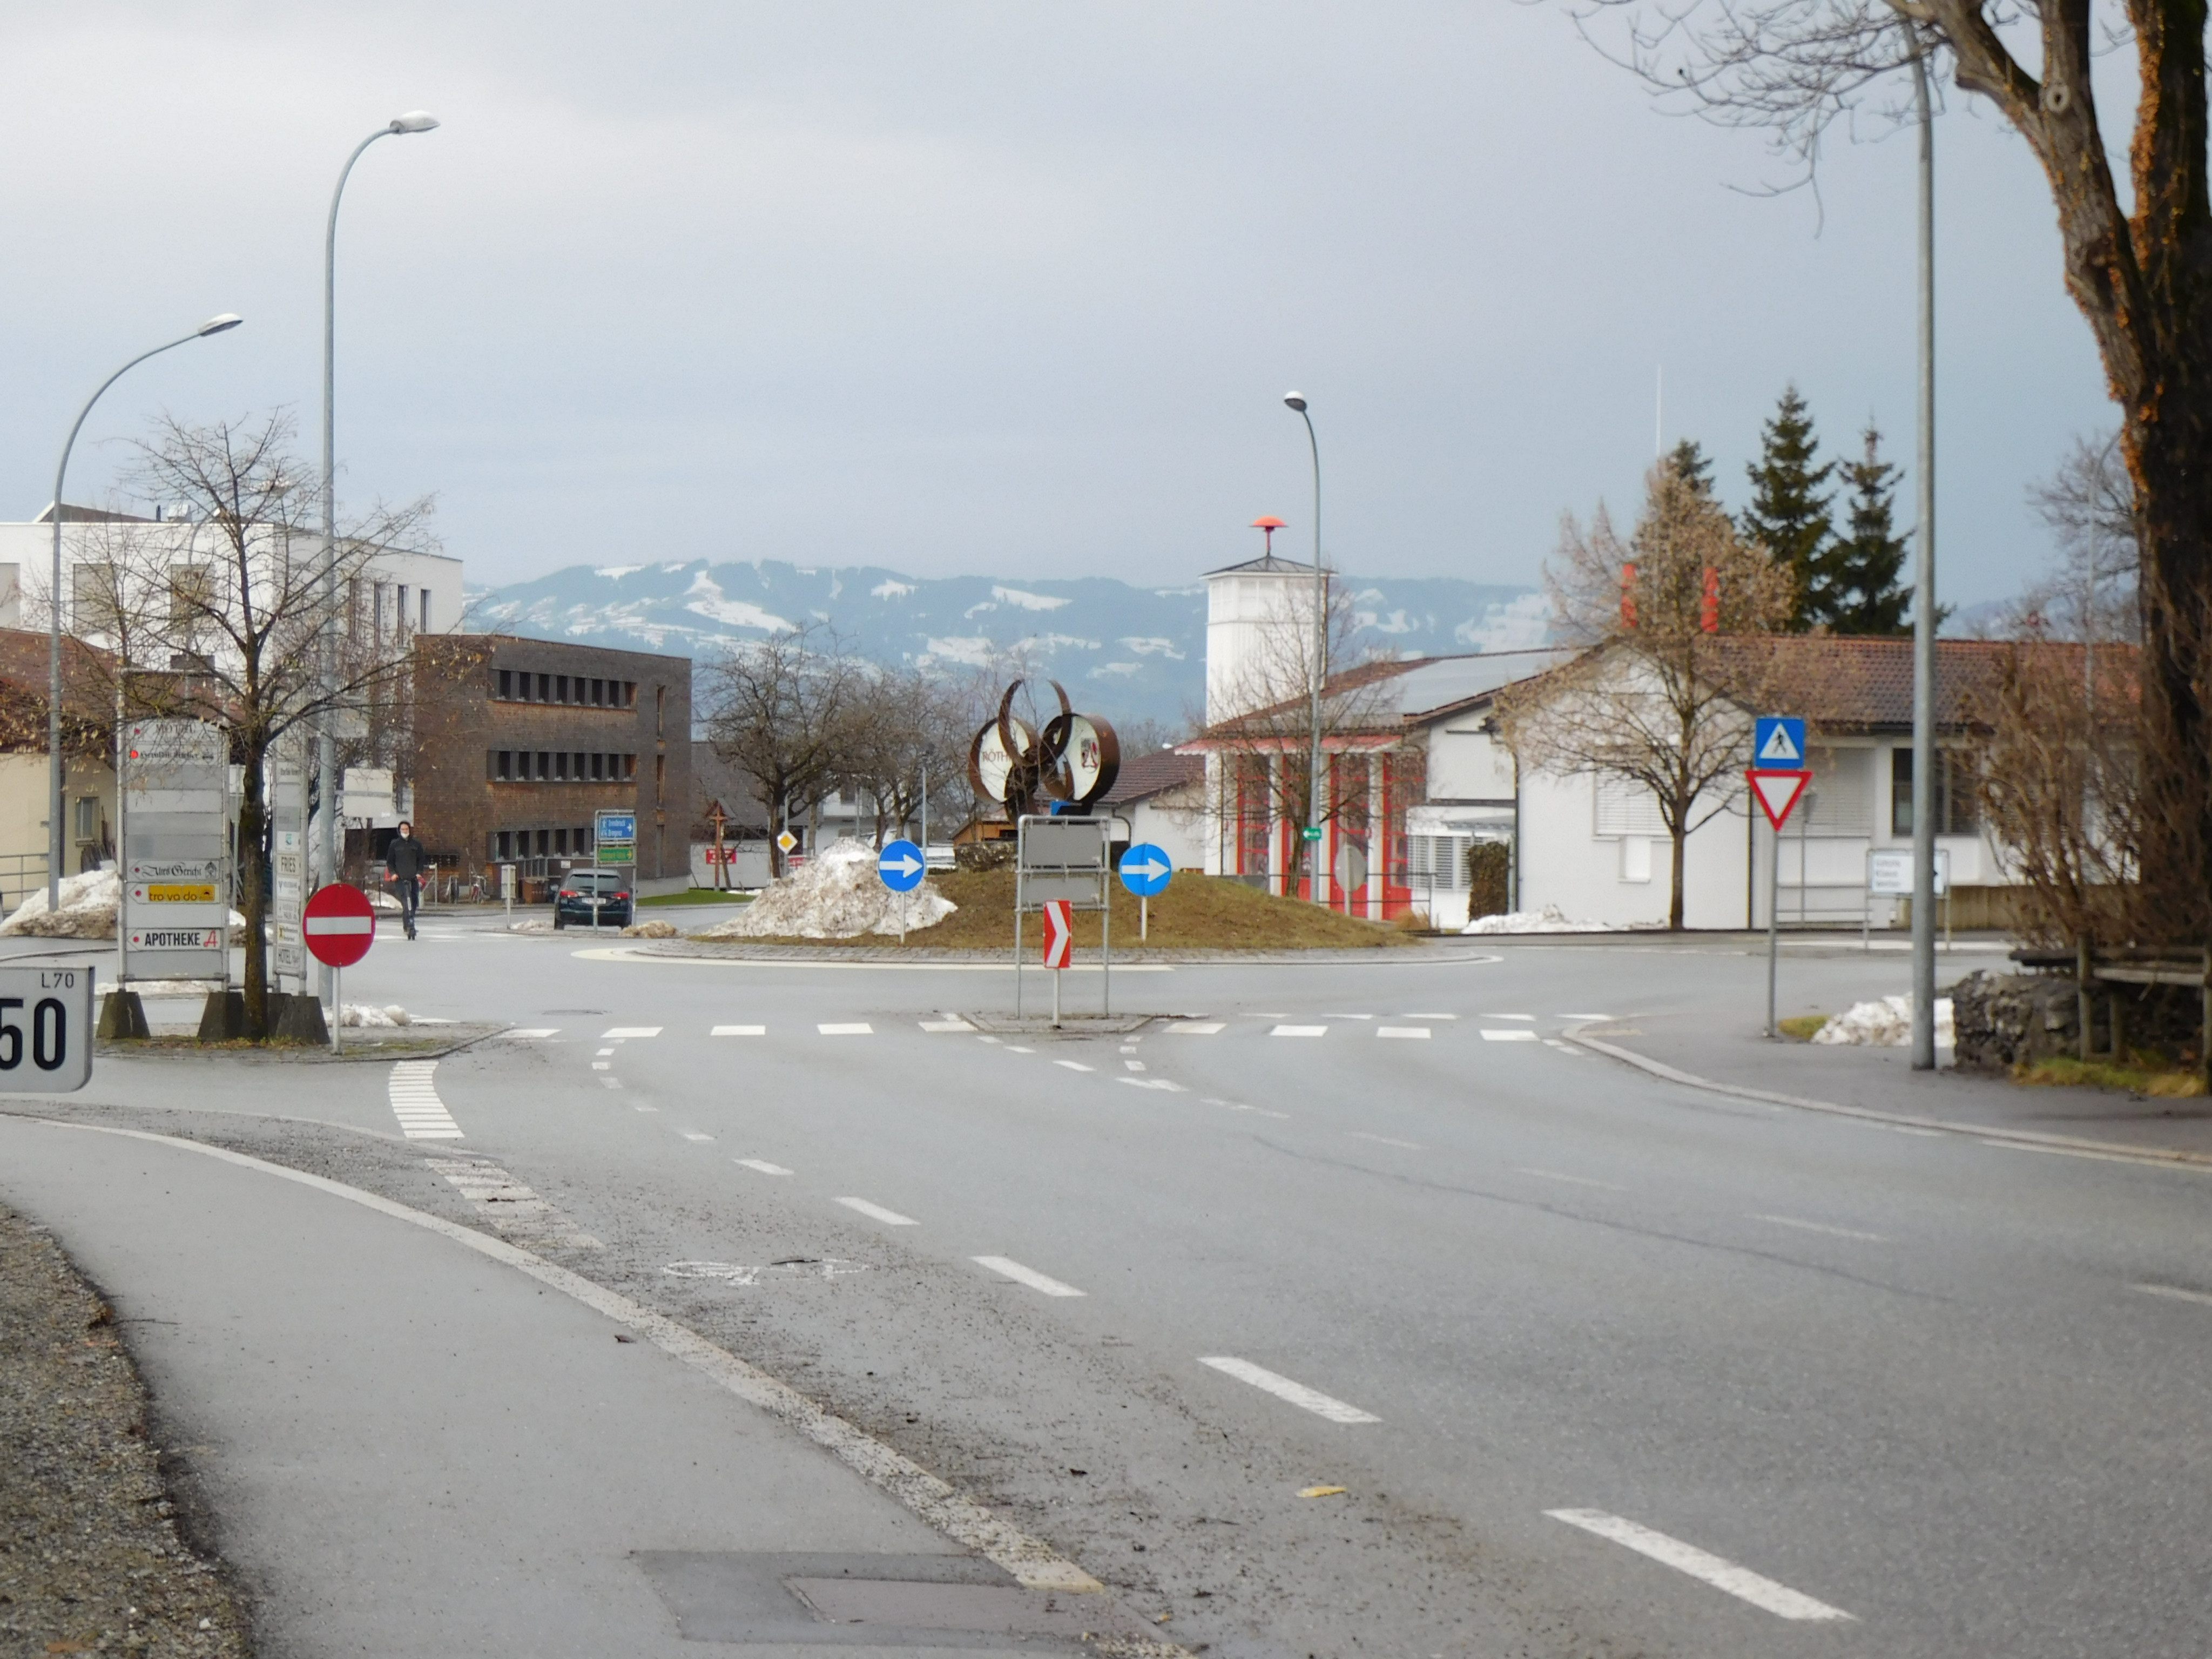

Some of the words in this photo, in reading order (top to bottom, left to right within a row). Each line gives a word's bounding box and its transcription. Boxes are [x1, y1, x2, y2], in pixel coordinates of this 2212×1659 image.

[281, 857, 296, 873] FRIES
[144, 932, 200, 947] APOTHEKE
[41, 972, 75, 989] L70
[0, 997, 66, 1070] 50
